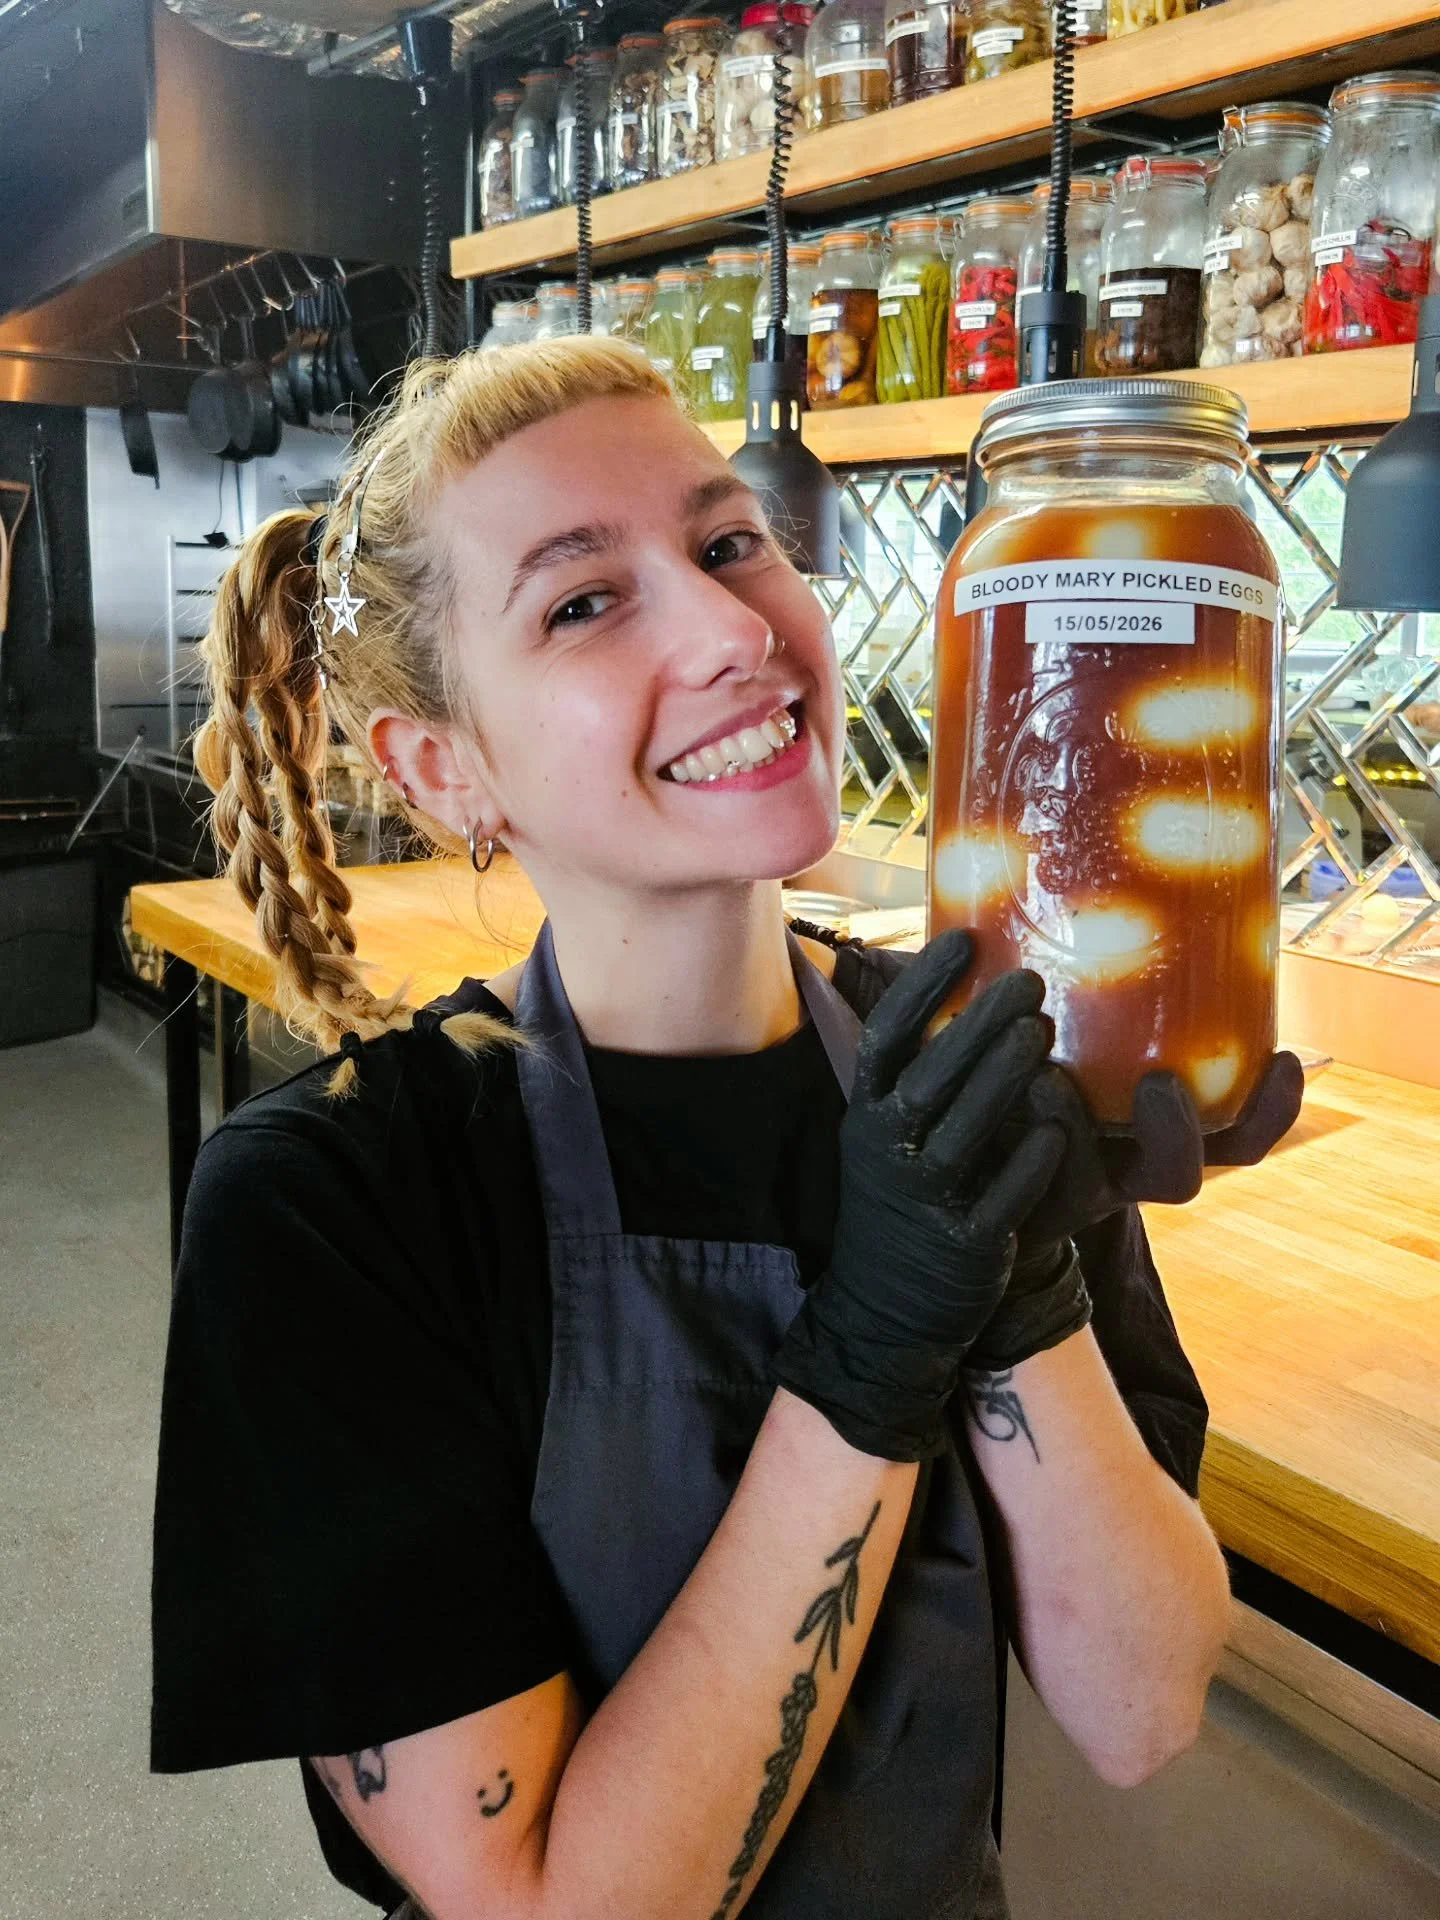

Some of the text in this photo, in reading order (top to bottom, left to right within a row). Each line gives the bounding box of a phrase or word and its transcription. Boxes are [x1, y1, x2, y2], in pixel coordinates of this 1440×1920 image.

[971, 572, 1264, 605] BLOODY MARY PICKLED EGGS
[1053, 615, 1163, 632] 15/05/2026
